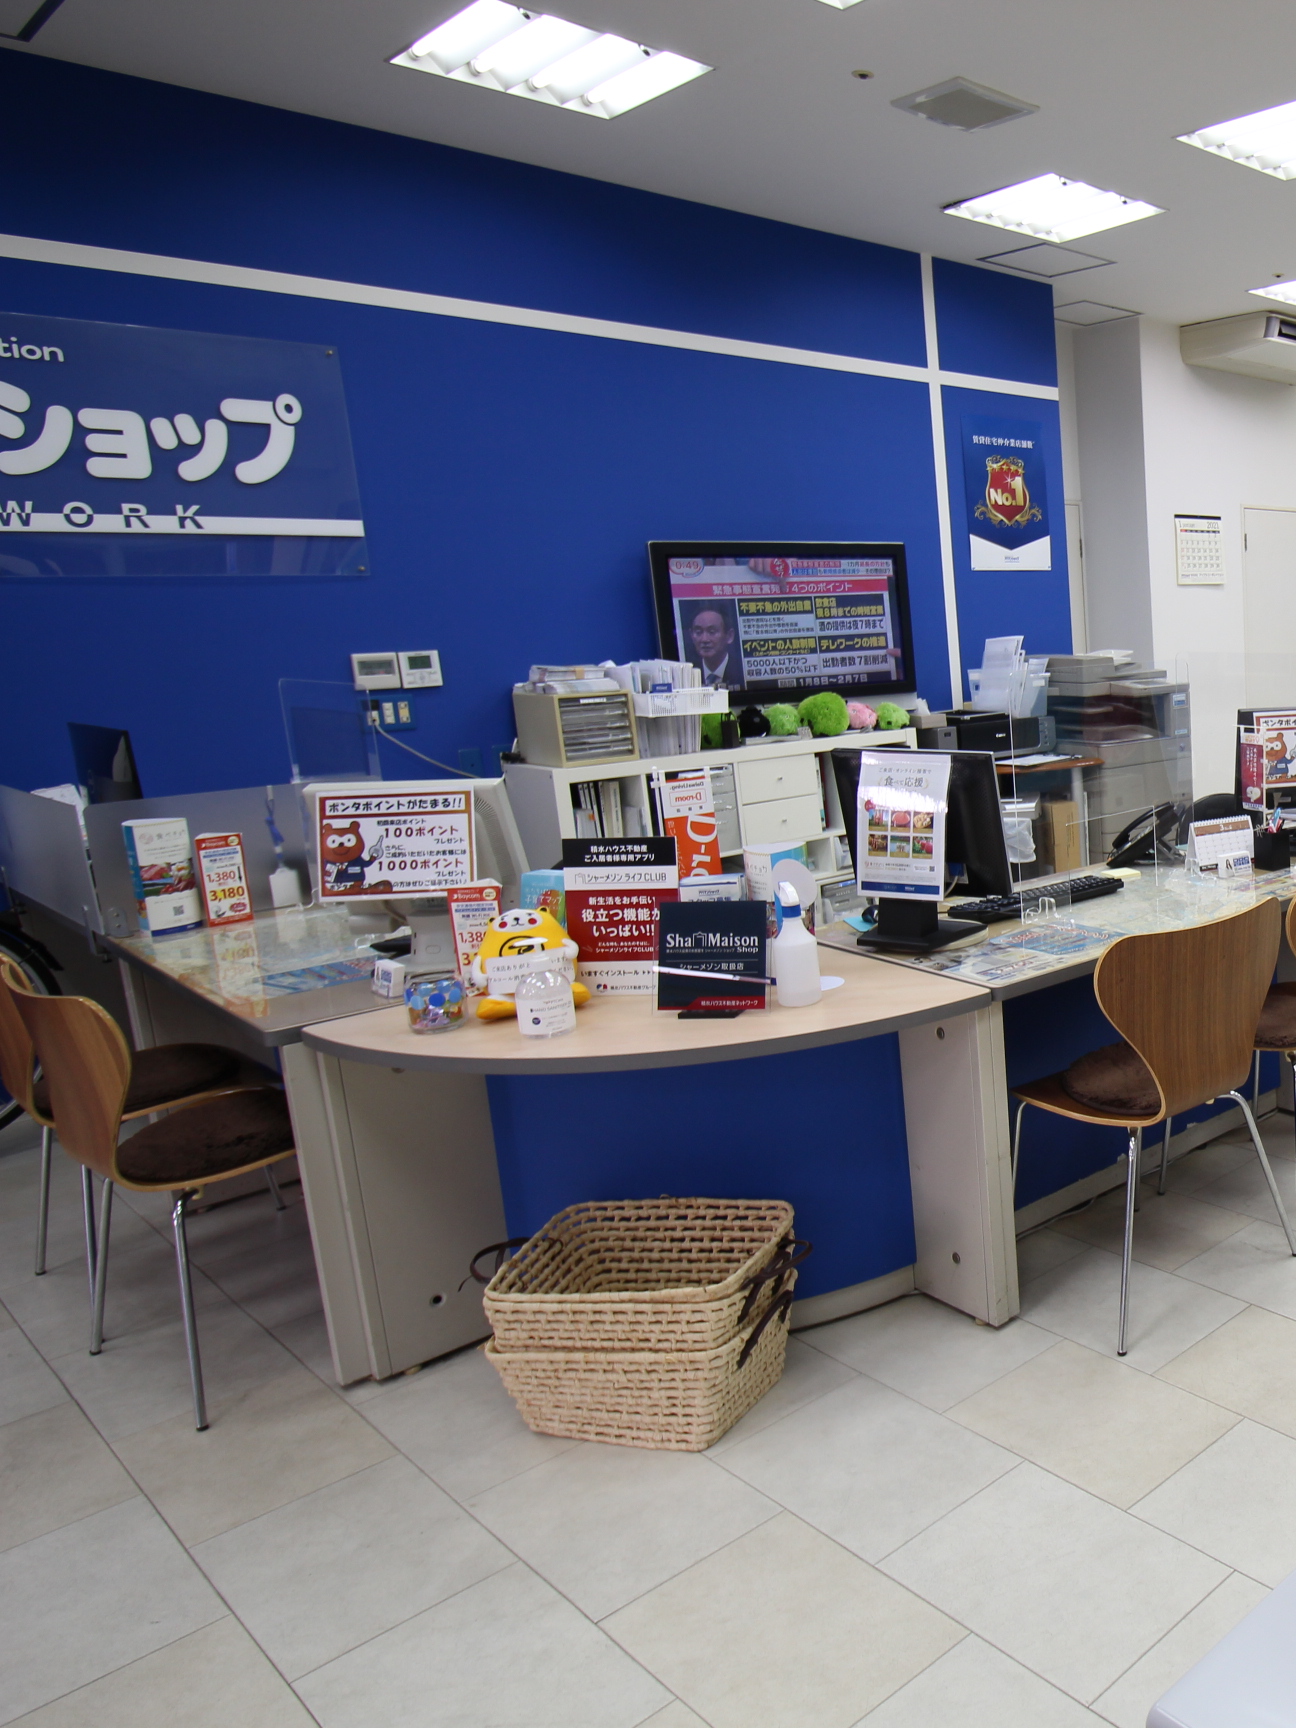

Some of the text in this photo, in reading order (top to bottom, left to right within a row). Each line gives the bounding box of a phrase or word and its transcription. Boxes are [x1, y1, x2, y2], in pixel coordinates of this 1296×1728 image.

[0, 381, 302, 484] ショップ
[989, 476, 1024, 506] No.1
[713, 583, 790, 595] 緊急事態宣言発
[384, 825, 459, 838] 100ポイント
[590, 845, 648, 853] 積水ハウス不動産
[584, 853, 655, 863] ご入居者様専用アプリ
[378, 858, 464, 872] 1000ポイント
[206, 870, 236, 883] 1,380
[587, 872, 667, 883] シャーメゾン ライフ CLUB
[209, 886, 245, 903] 3,180
[588, 896, 656, 906] 新生活をお手伝い
[592, 924, 655, 937] いっぱい!!
[665, 932, 759, 948] Sha Maison
[679, 962, 744, 971] シャーメゾン取扱店
